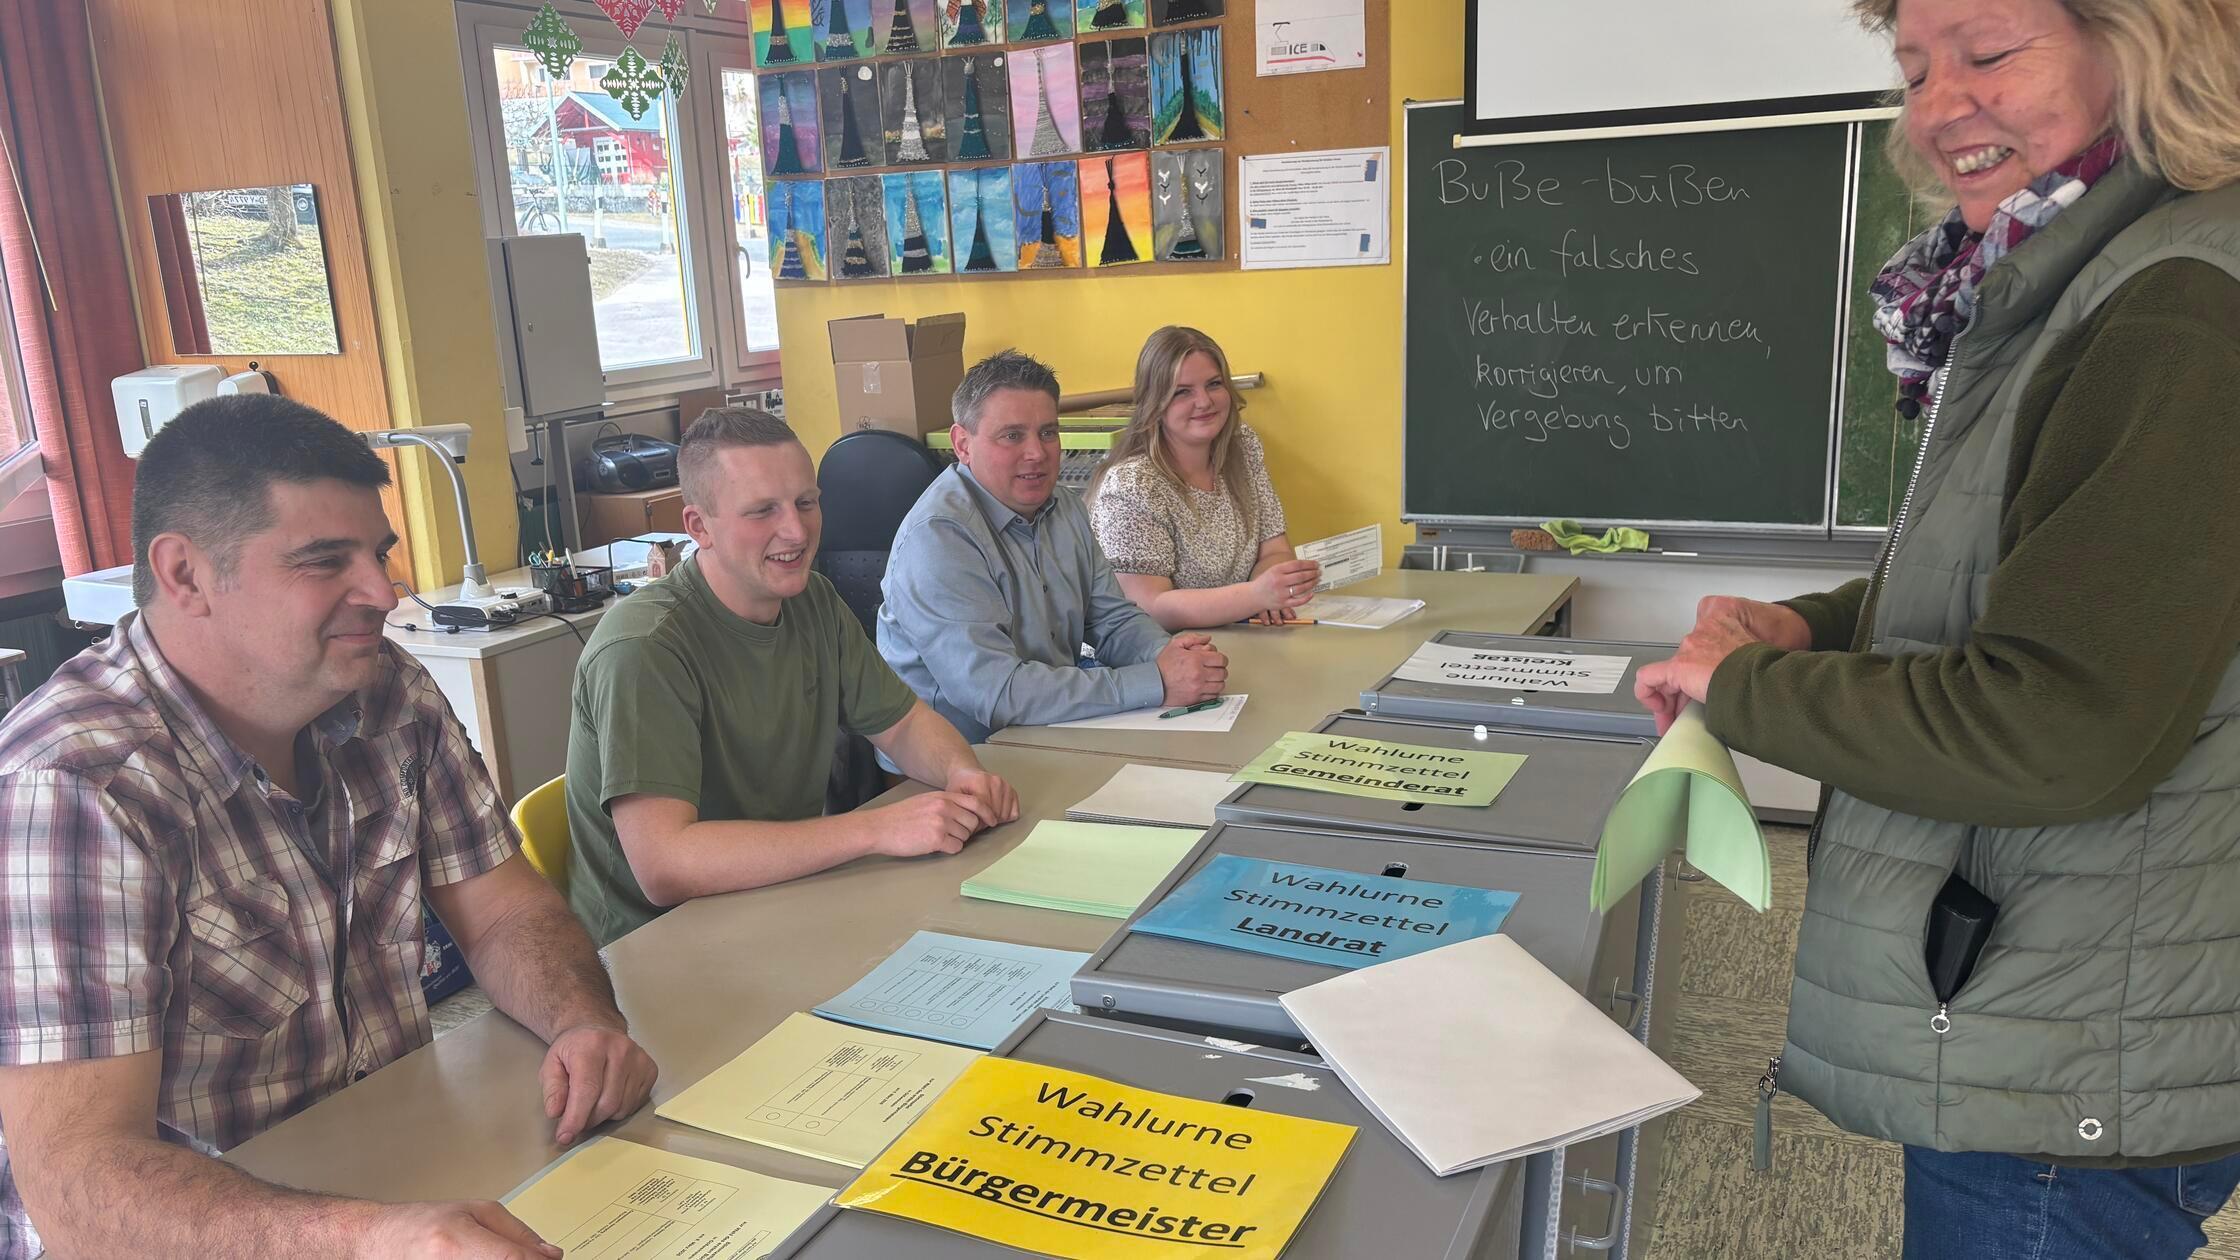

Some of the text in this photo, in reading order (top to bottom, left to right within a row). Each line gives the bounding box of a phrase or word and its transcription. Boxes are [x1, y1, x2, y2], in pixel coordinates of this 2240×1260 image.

[1289, 43, 1308, 55] ICE
[1550, 228, 1699, 277] falsches
[1463, 297, 1771, 359] Verhalten erkennen,
[1636, 364, 1682, 385] um
[1479, 400, 1749, 449] Vergebung bitten
[1440, 662, 1592, 678] Stimmzettel
[1472, 653, 1573, 666] Kreistag
[1445, 673, 1569, 687] Wahlurne
[1294, 751, 1470, 780] Stimmzettel
[1329, 739, 1465, 764] Wahlurne
[1269, 763, 1468, 797] Gemeinderat
[1271, 871, 1444, 909] Wahlurne
[1223, 888, 1450, 936] Stimmzettel
[1236, 917, 1387, 955] Landrat
[1037, 1082, 1253, 1151] Wahlurne
[968, 1115, 1257, 1197] Stimmzettel
[899, 1150, 1258, 1245] Bürgermeister
